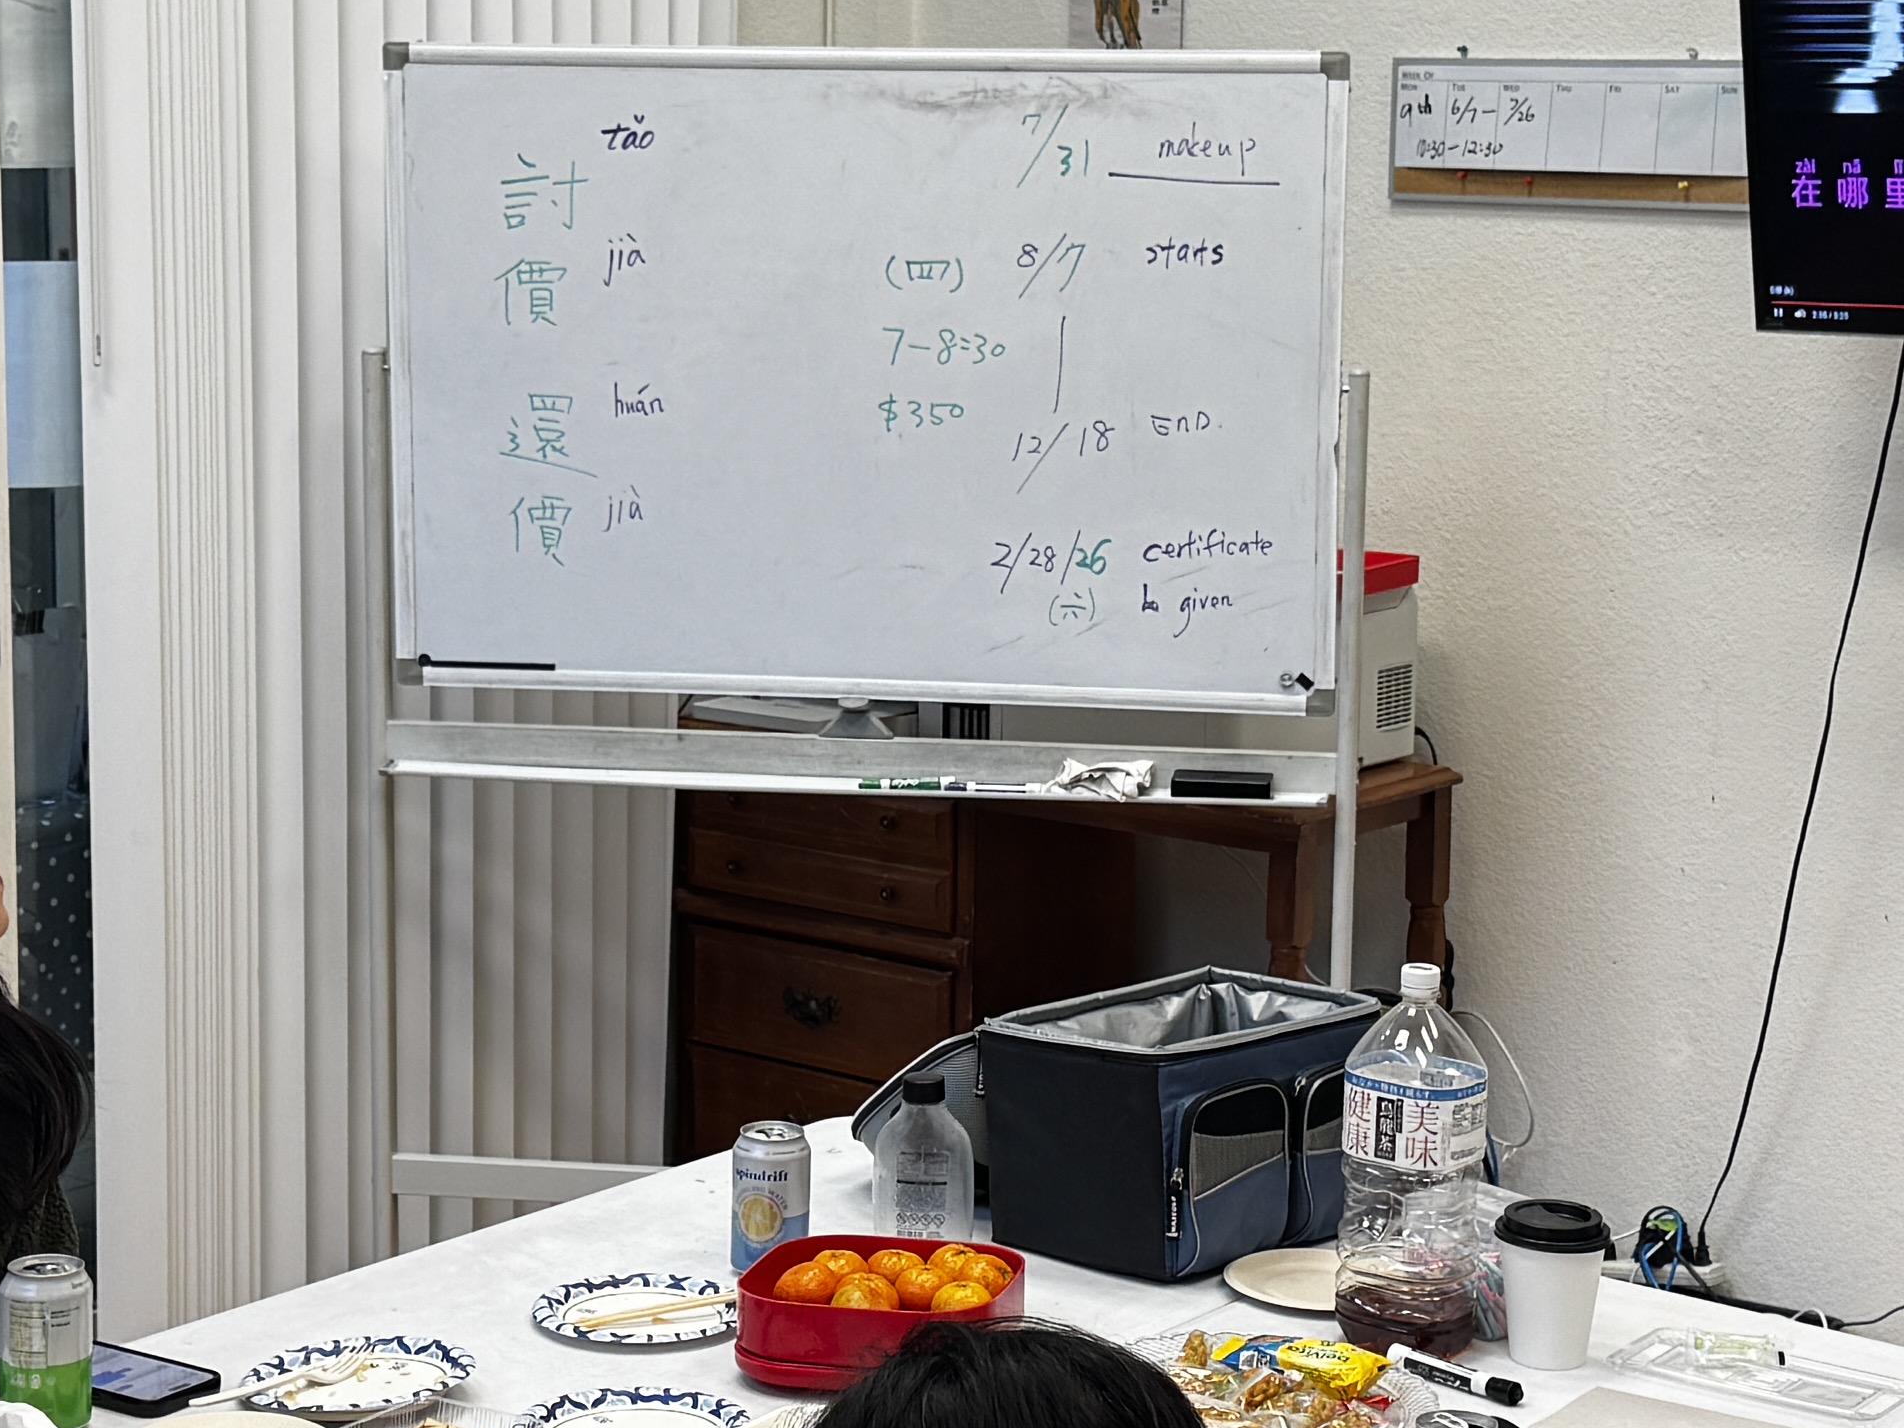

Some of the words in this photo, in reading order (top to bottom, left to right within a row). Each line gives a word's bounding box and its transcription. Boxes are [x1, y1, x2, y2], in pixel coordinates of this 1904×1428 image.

[1158, 121, 1257, 176] makeup
[1016, 233, 1086, 299] 8/7
[1145, 236, 1225, 270] starts
[878, 393, 965, 432] $350
[1142, 528, 1275, 564] certificate
[1172, 587, 1234, 639] given
[1347, 1086, 1372, 1157] 健康
[1405, 1101, 1440, 1169] 美味
